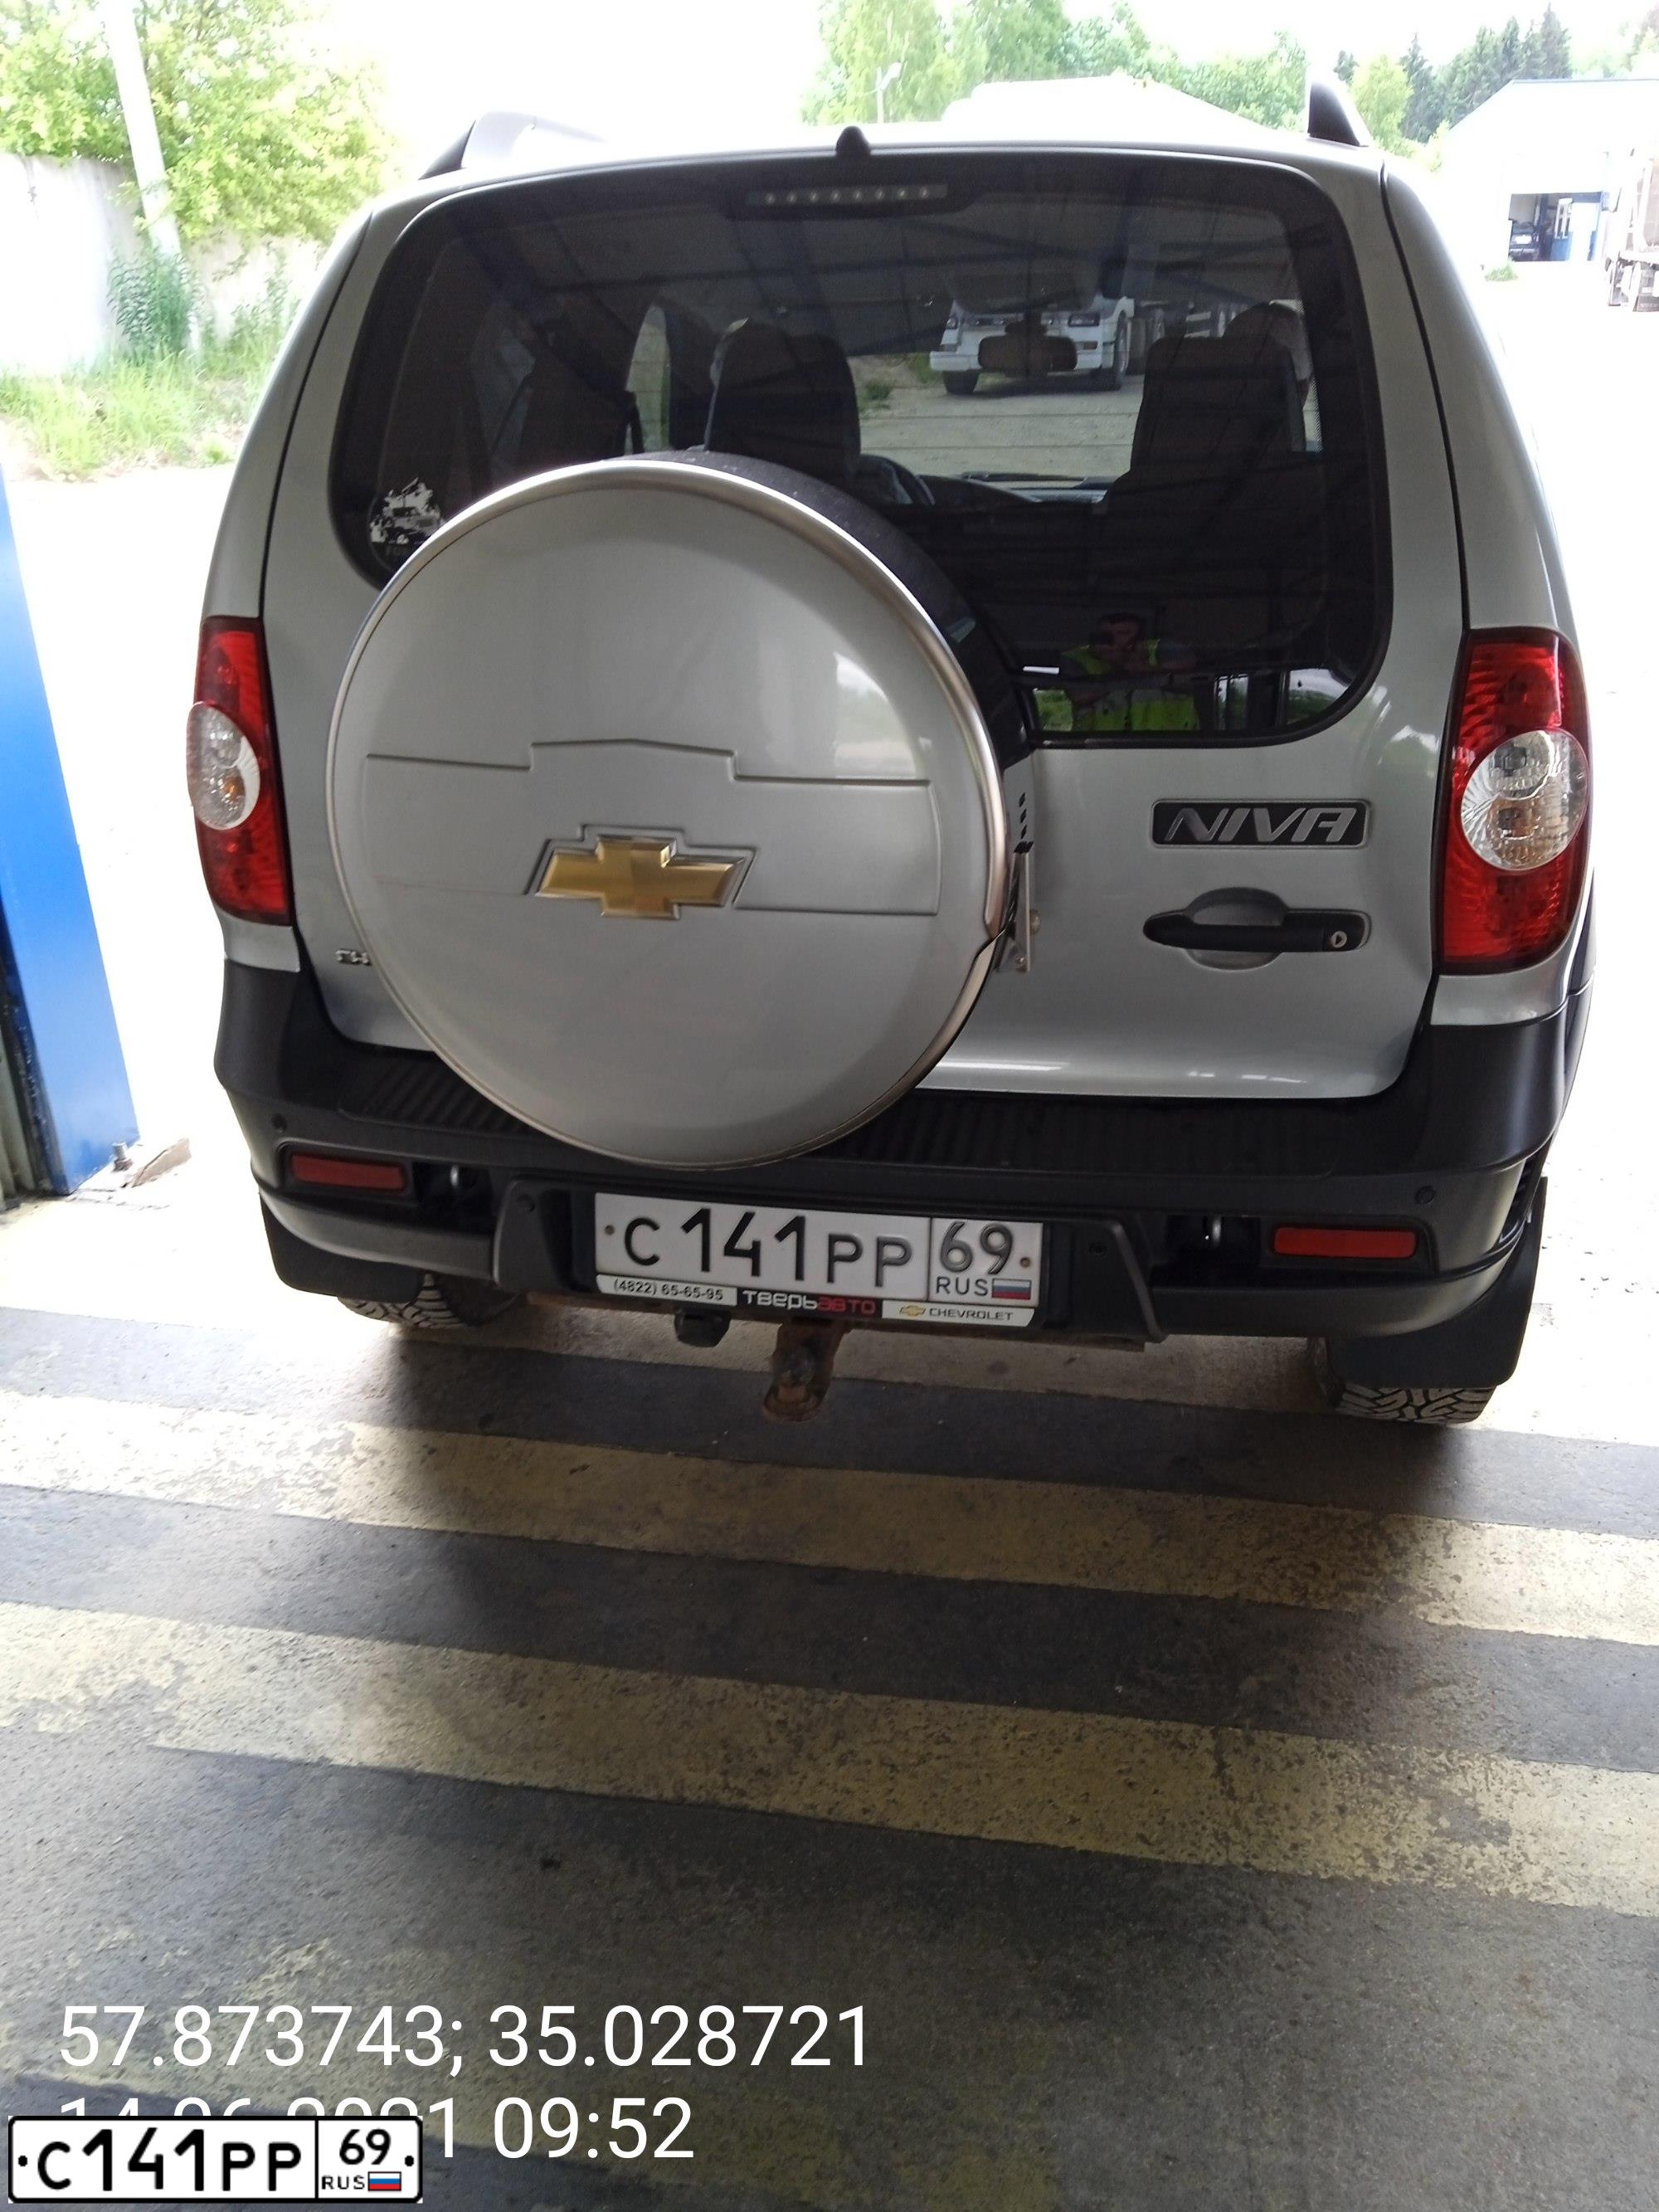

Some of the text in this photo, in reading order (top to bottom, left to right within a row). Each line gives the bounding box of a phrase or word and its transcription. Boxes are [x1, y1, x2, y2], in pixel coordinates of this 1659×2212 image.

[1164, 807, 1357, 842] NIVA
[940, 1220, 1014, 1274] 69
[936, 1275, 989, 1296] RUS
[928, 1308, 1014, 1321] CHEVROLET
